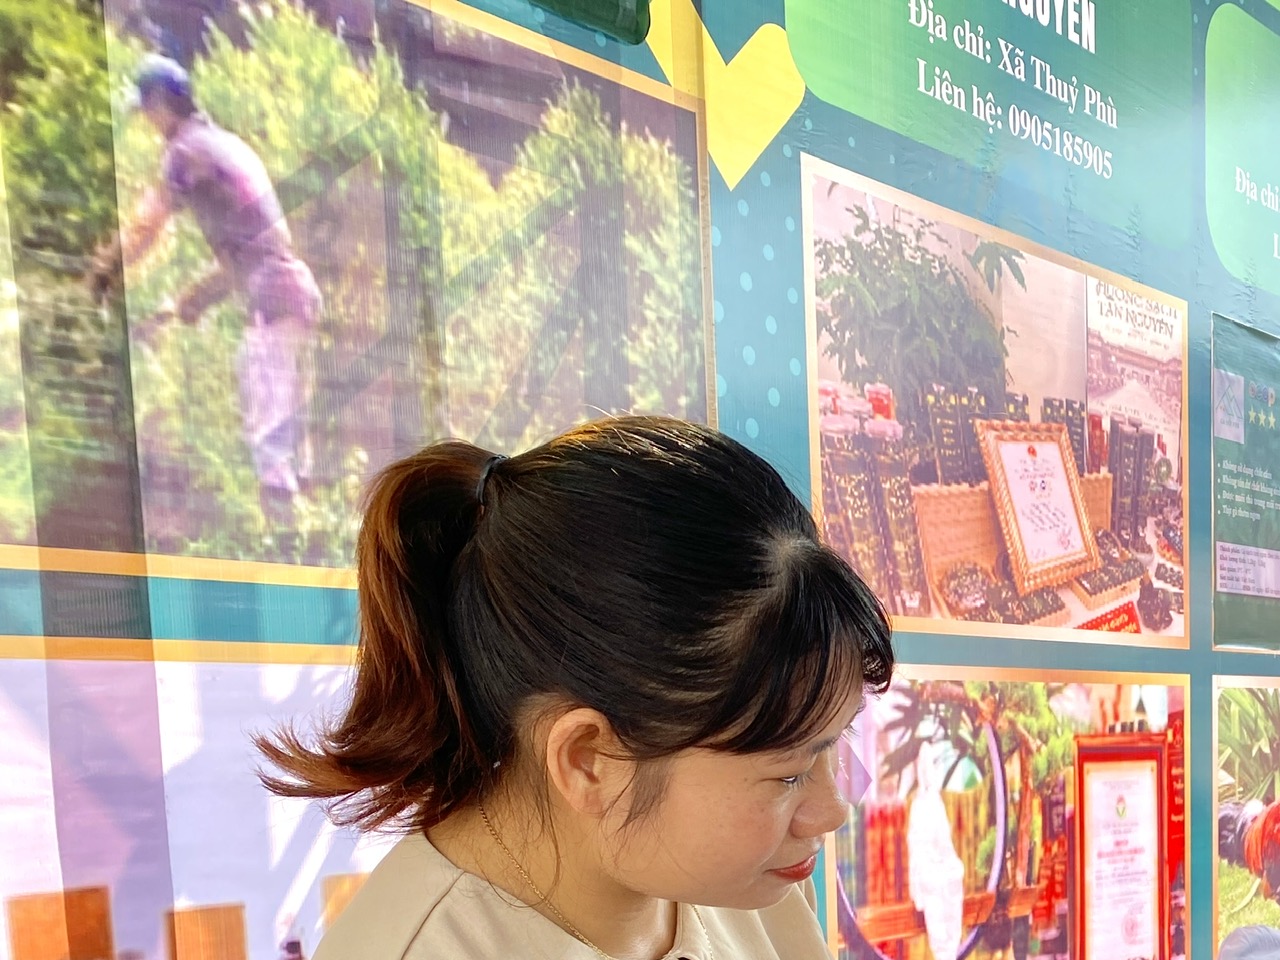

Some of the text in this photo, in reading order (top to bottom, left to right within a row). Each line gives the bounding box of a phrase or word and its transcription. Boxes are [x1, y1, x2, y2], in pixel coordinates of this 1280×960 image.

[908, 0, 947, 43] Địa
[953, 19, 991, 64] chỉ:
[998, 38, 1026, 82] Xã
[1083, 84, 1118, 129] Phù
[917, 57, 1113, 179] Liên hệ: 0905185905
[1235, 166, 1257, 205] Địa
